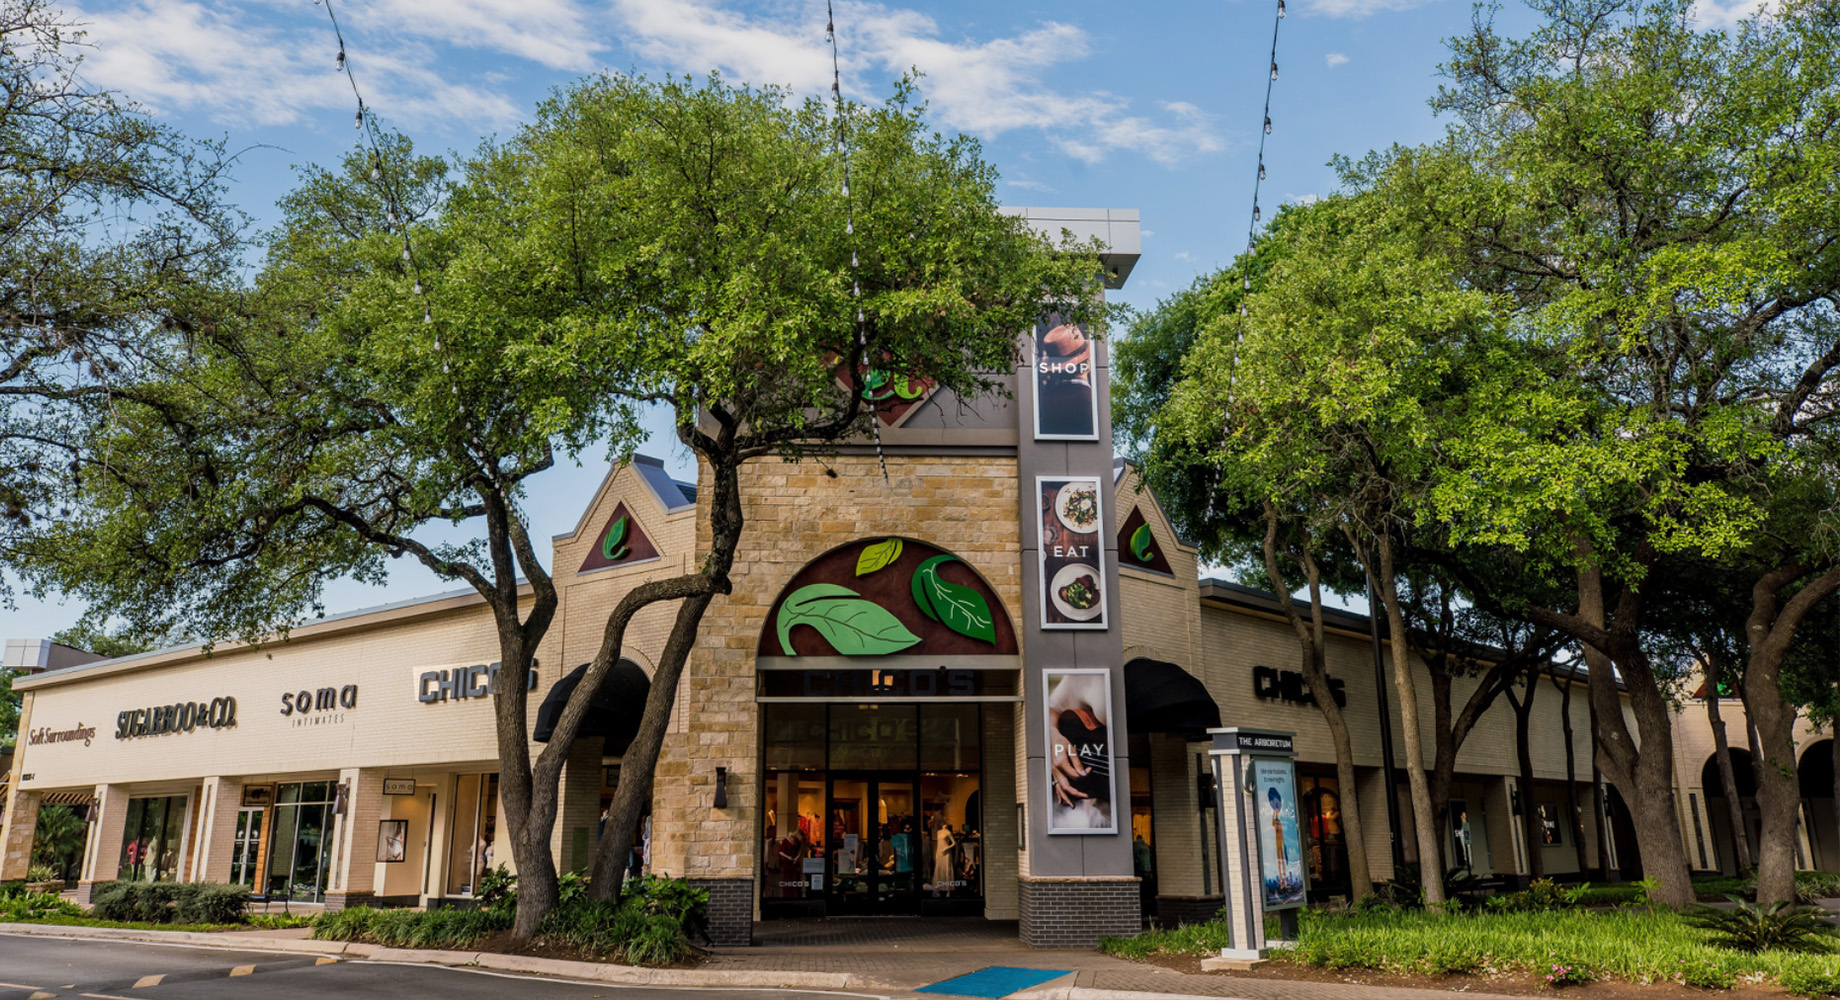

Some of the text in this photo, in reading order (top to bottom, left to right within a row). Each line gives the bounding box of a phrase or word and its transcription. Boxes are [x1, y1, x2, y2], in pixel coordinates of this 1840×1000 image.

[1039, 362, 1089, 374] SHOP
[1053, 545, 1089, 558] EAT
[418, 658, 537, 703] CHIC
[280, 685, 357, 716] soma
[292, 714, 345, 728] INTIMATES
[29, 722, 96, 747] Soft Surroundings
[1239, 737, 1292, 748] THE ARBORETUM
[1054, 743, 1104, 757] PLAY
[386, 783, 413, 791] soma
